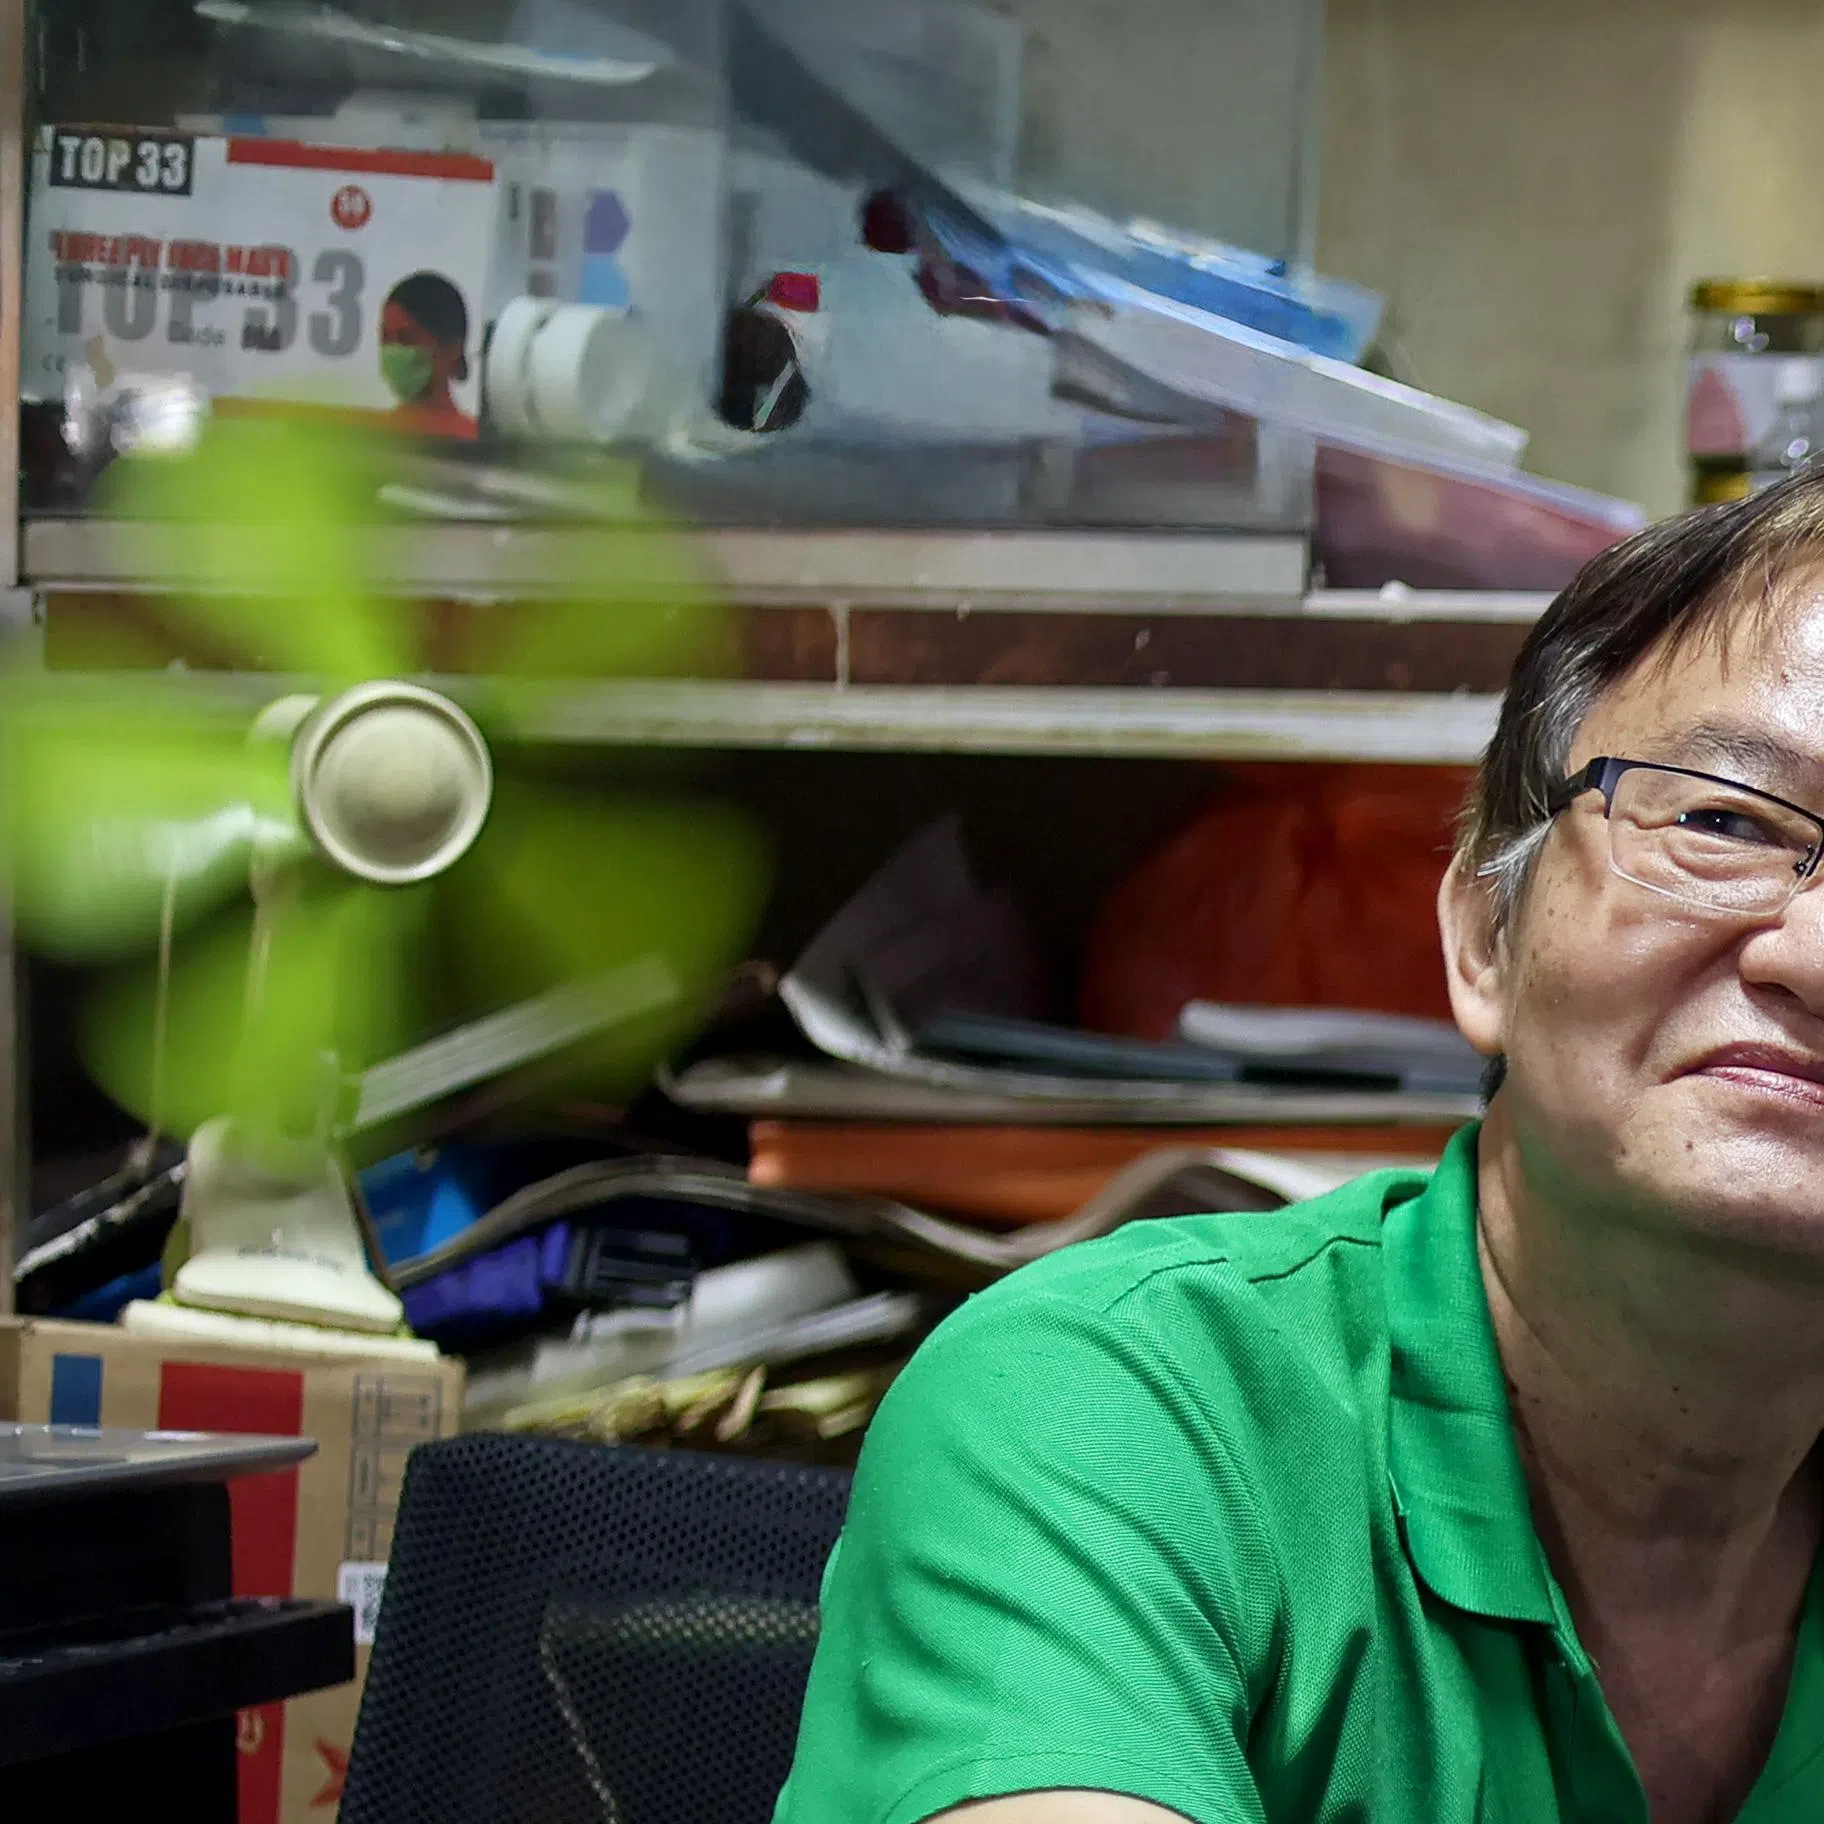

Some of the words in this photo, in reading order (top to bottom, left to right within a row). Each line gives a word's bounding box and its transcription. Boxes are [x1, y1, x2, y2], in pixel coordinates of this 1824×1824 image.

[58, 136, 131, 182] TOP
[135, 141, 188, 189] 33
[50, 230, 222, 343] TOP
[242, 244, 365, 355] 33
